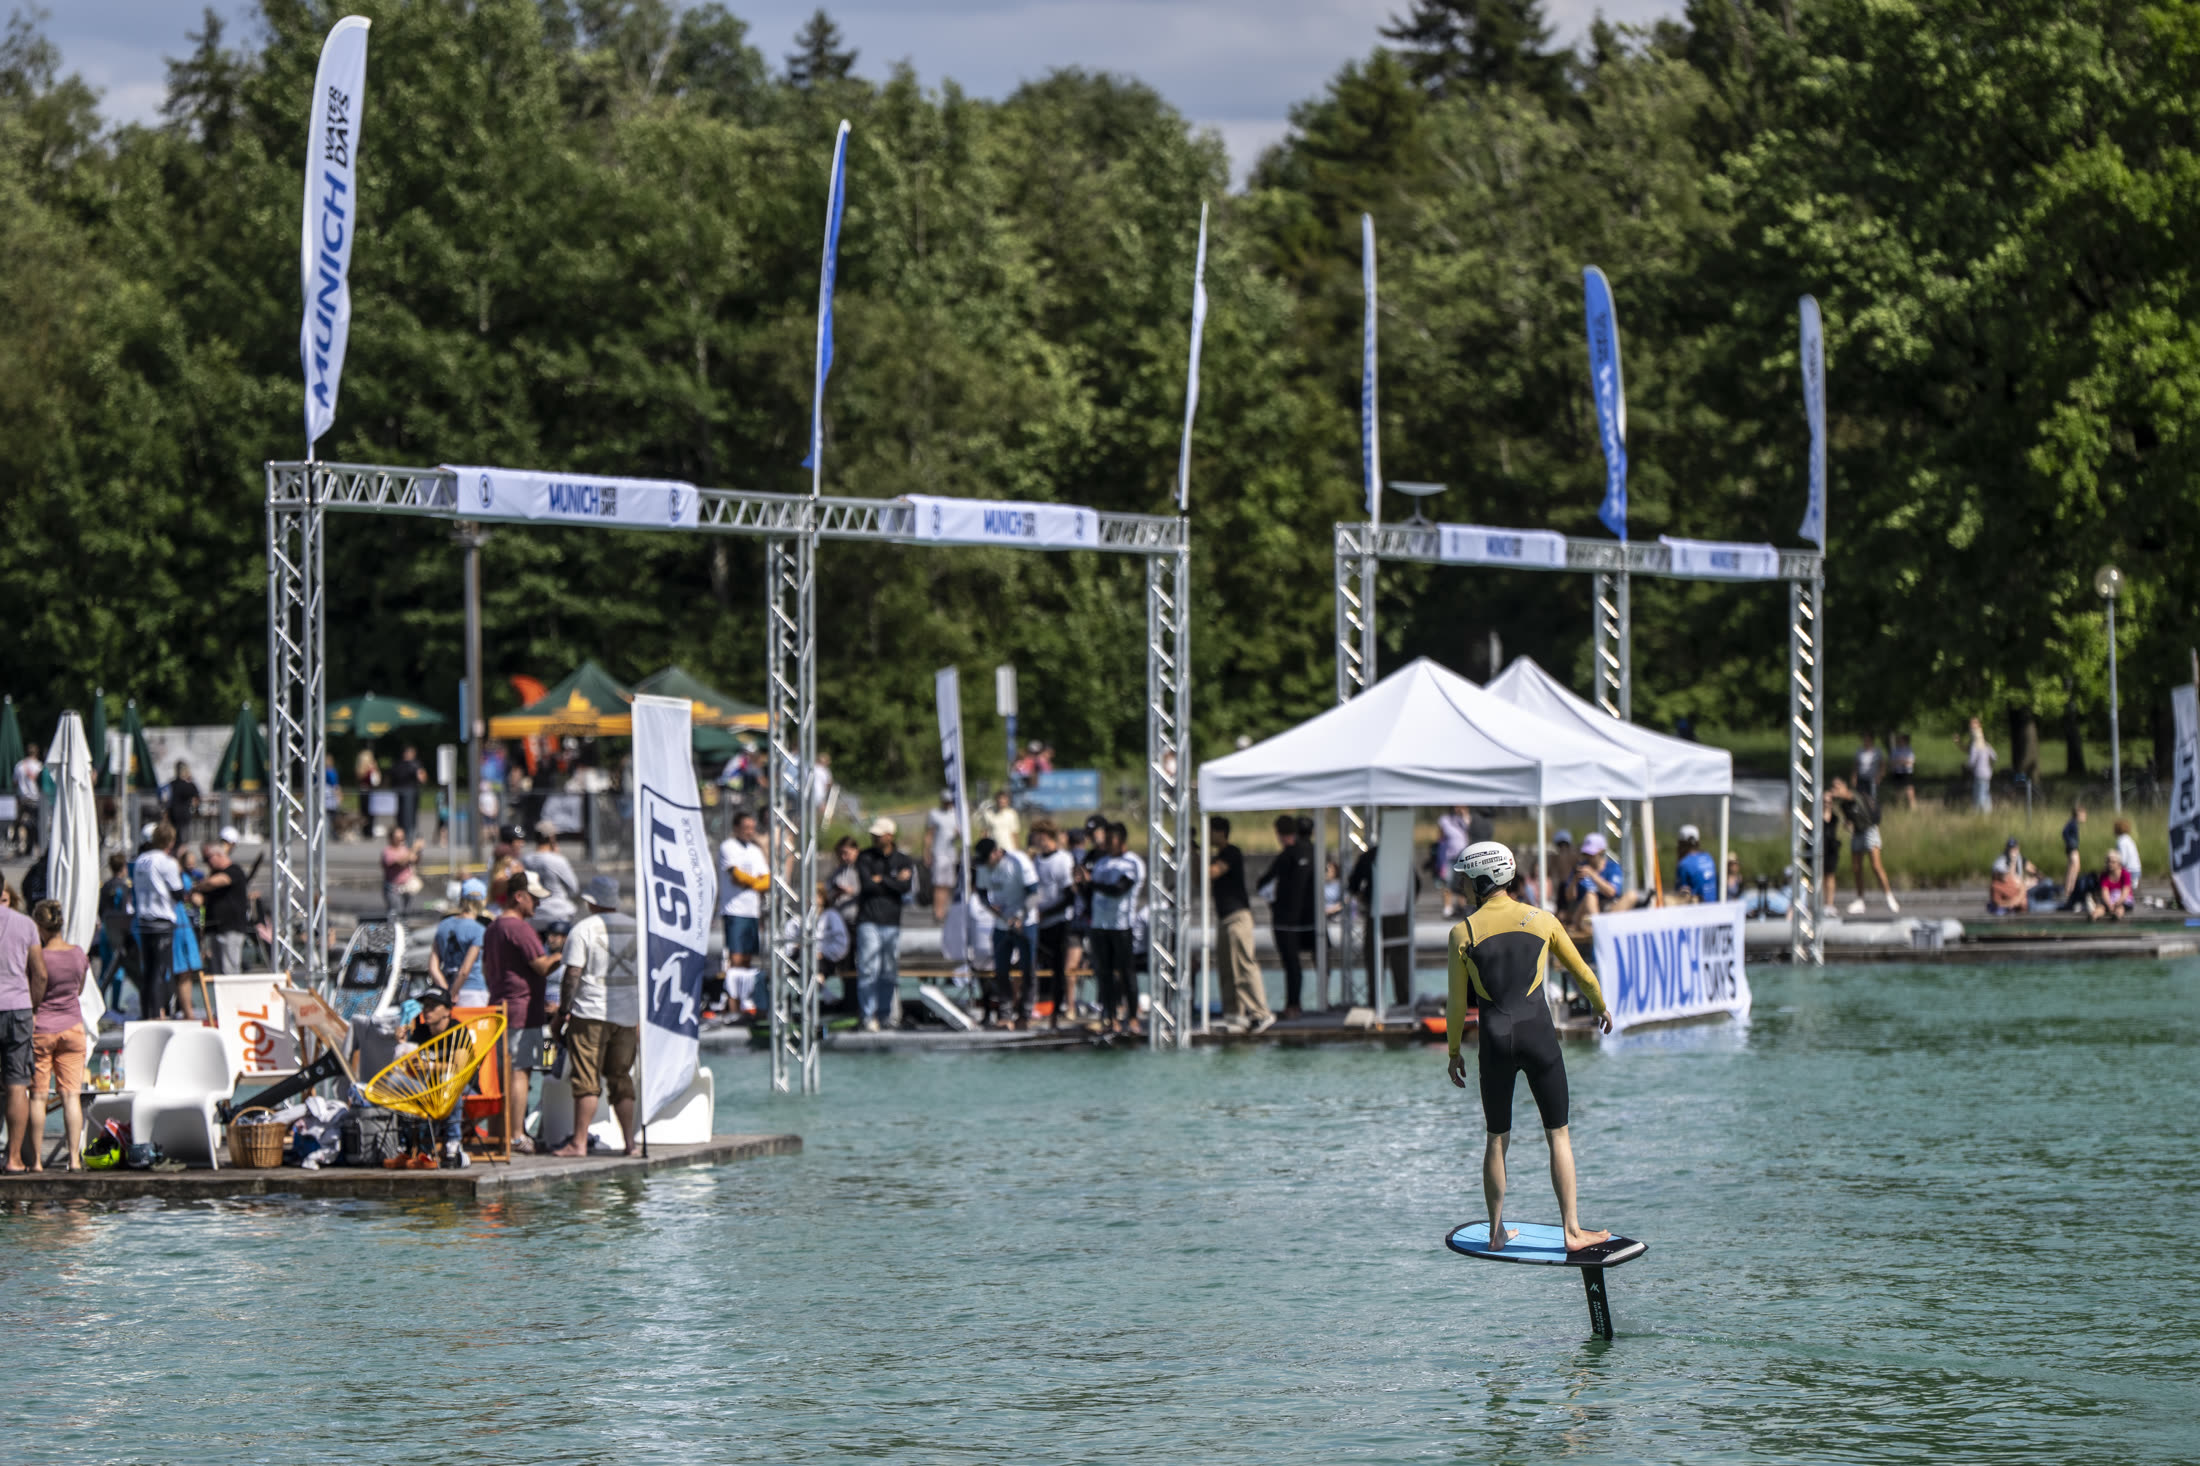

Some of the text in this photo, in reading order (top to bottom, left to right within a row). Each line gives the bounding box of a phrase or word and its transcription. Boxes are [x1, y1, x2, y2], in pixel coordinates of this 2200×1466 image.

[325, 86, 341, 161] WATER
[334, 93, 349, 169] DAYS
[313, 170, 347, 409] MUNICH
[548, 483, 600, 514] MUNICH
[600, 500, 617, 516] DAYS
[983, 510, 1022, 537] MUNICH
[650, 802, 692, 931] SFT
[688, 847, 704, 887] WORLD
[1703, 923, 1735, 955] WATER
[1613, 927, 1703, 1017] MUNICH
[1704, 960, 1736, 1004] DAYS
